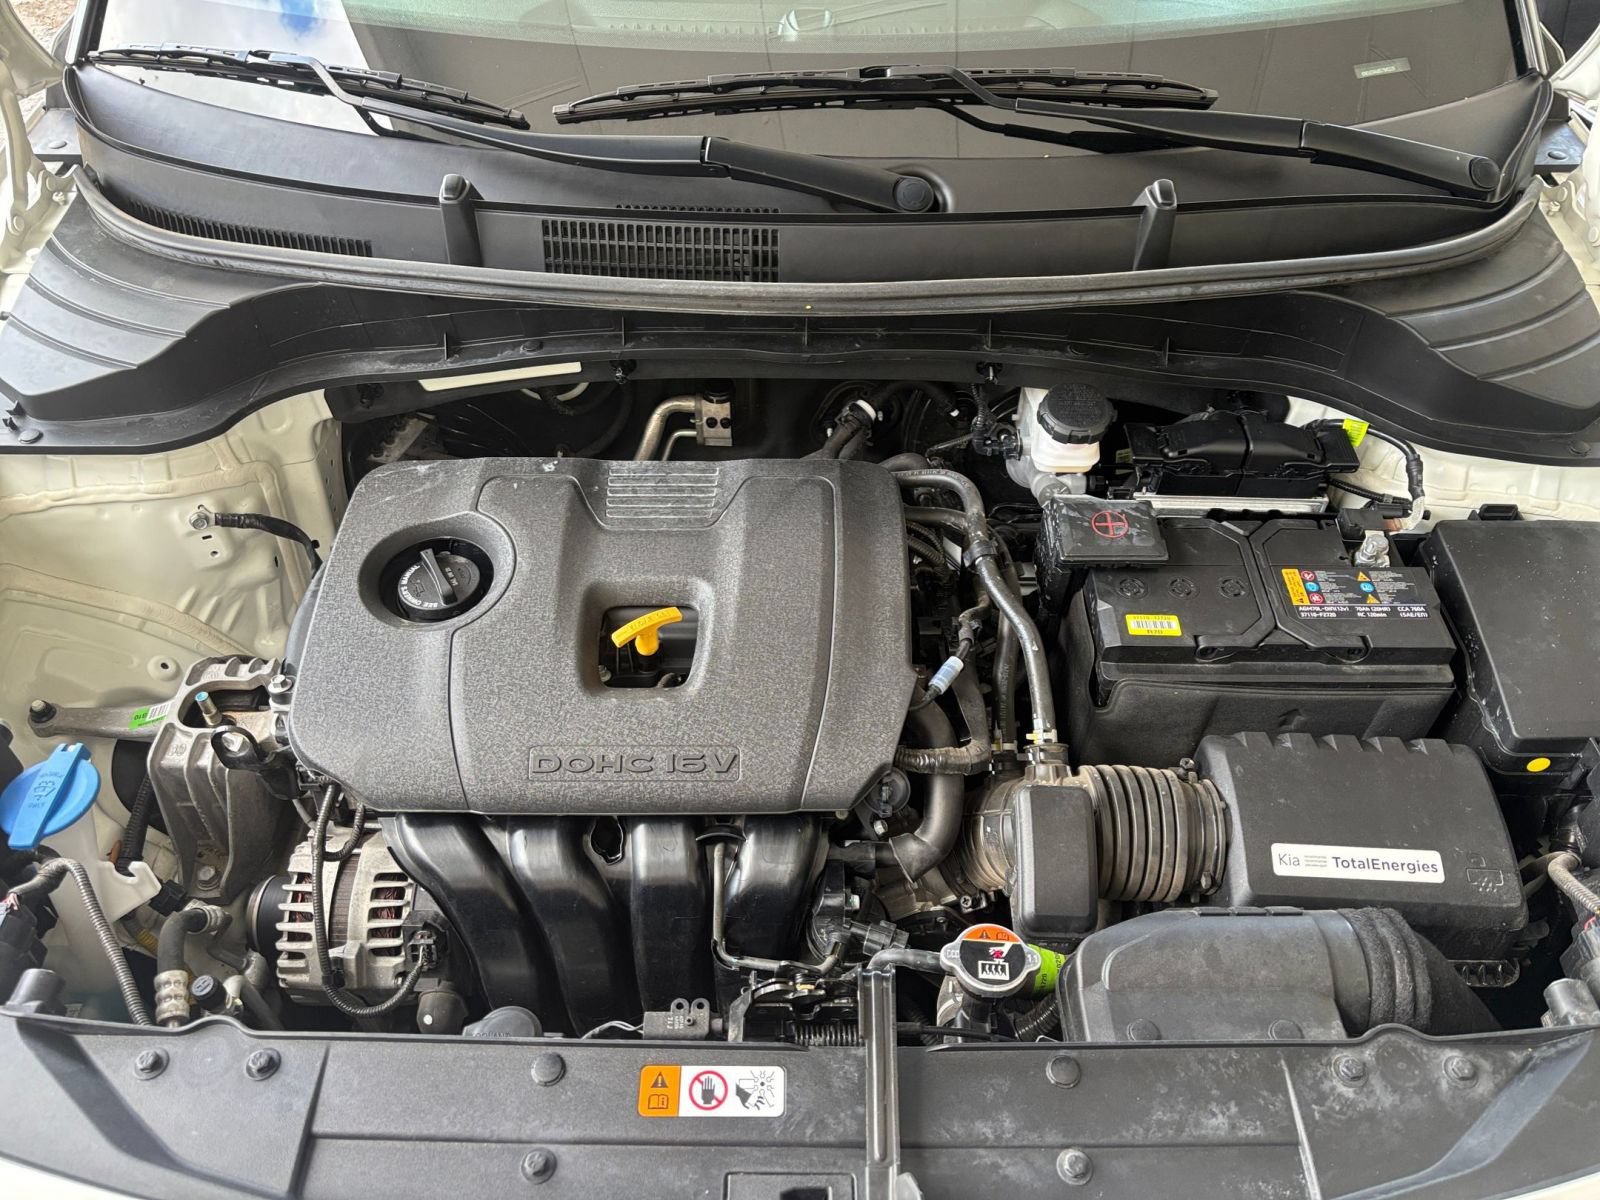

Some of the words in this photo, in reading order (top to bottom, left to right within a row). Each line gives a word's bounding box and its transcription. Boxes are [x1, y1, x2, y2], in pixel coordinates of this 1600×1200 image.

[532, 753, 654, 773] DOHC
[666, 753, 738, 773] 16V
[1278, 852, 1300, 867] Kia
[1332, 856, 1438, 874] TotalEnergies
